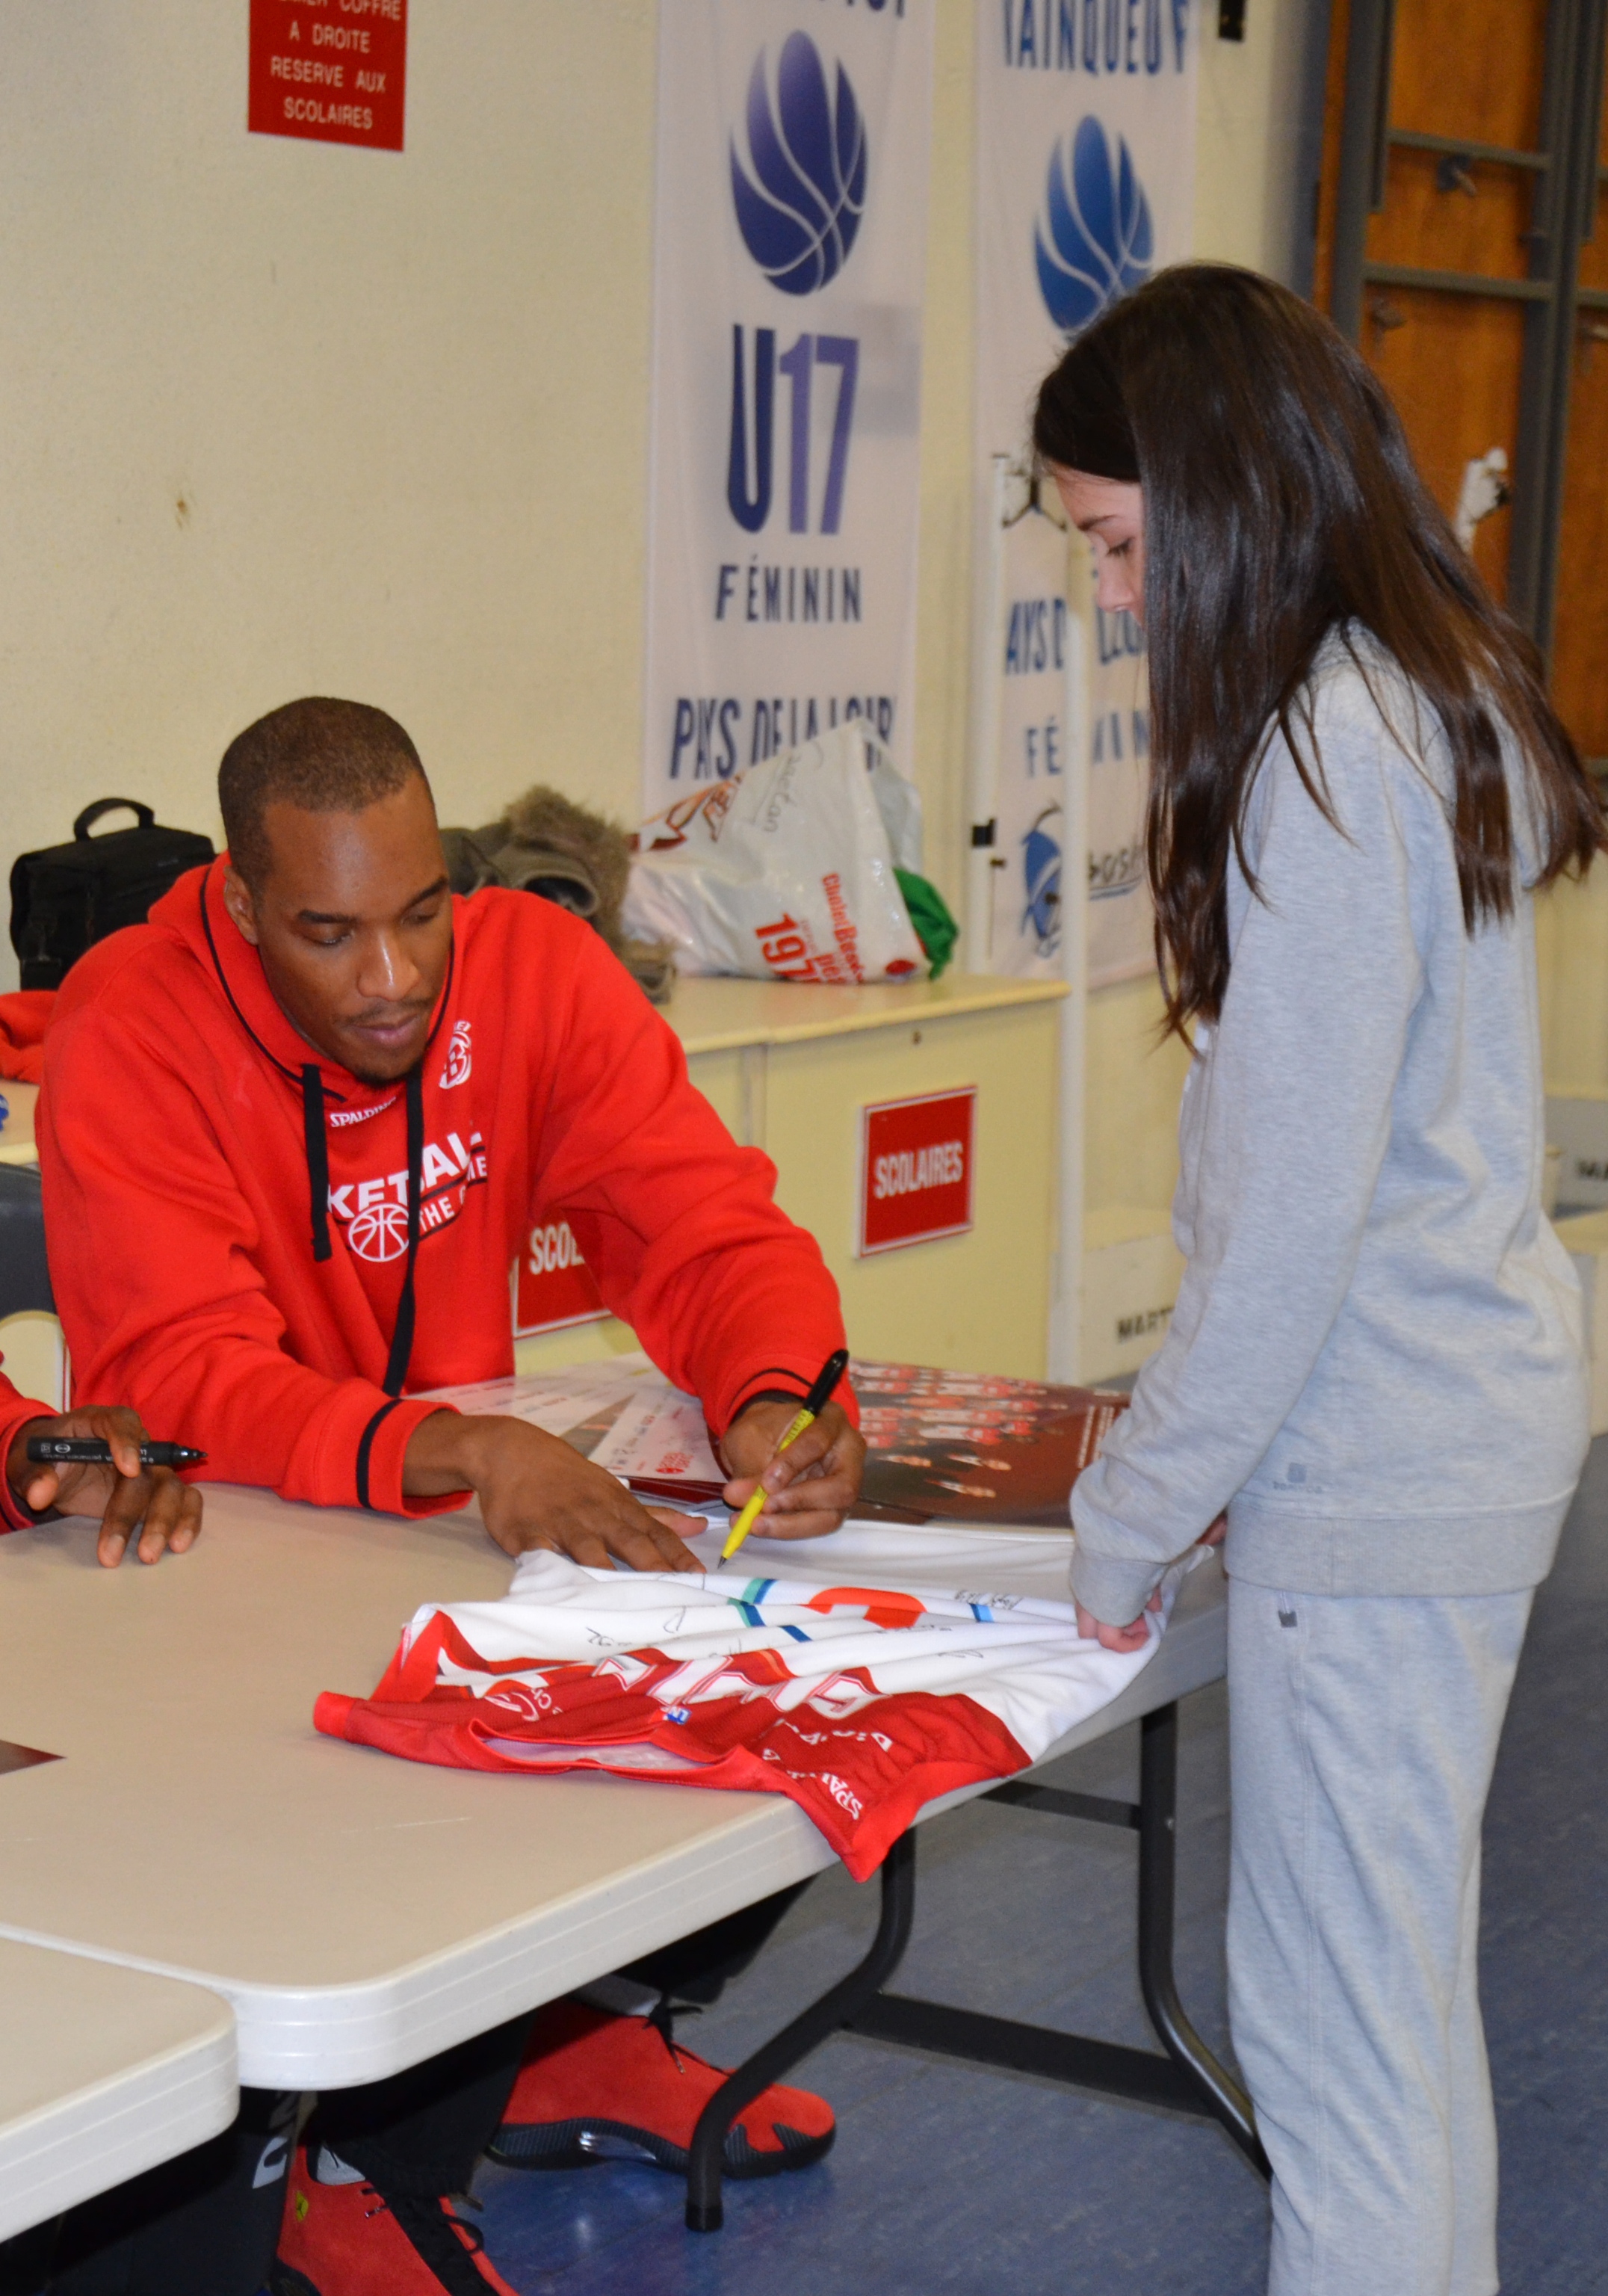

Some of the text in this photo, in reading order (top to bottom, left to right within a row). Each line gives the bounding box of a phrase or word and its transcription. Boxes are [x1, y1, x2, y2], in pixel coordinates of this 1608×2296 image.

[289, 20, 371, 54] A DROITE
[270, 55, 386, 93] RESERVE AUX
[283, 96, 373, 130] SCOLAIRES
[726, 324, 859, 535] U17
[714, 555, 862, 623] FÉMININ
[873, 1140, 964, 1199] SCOLAIRES
